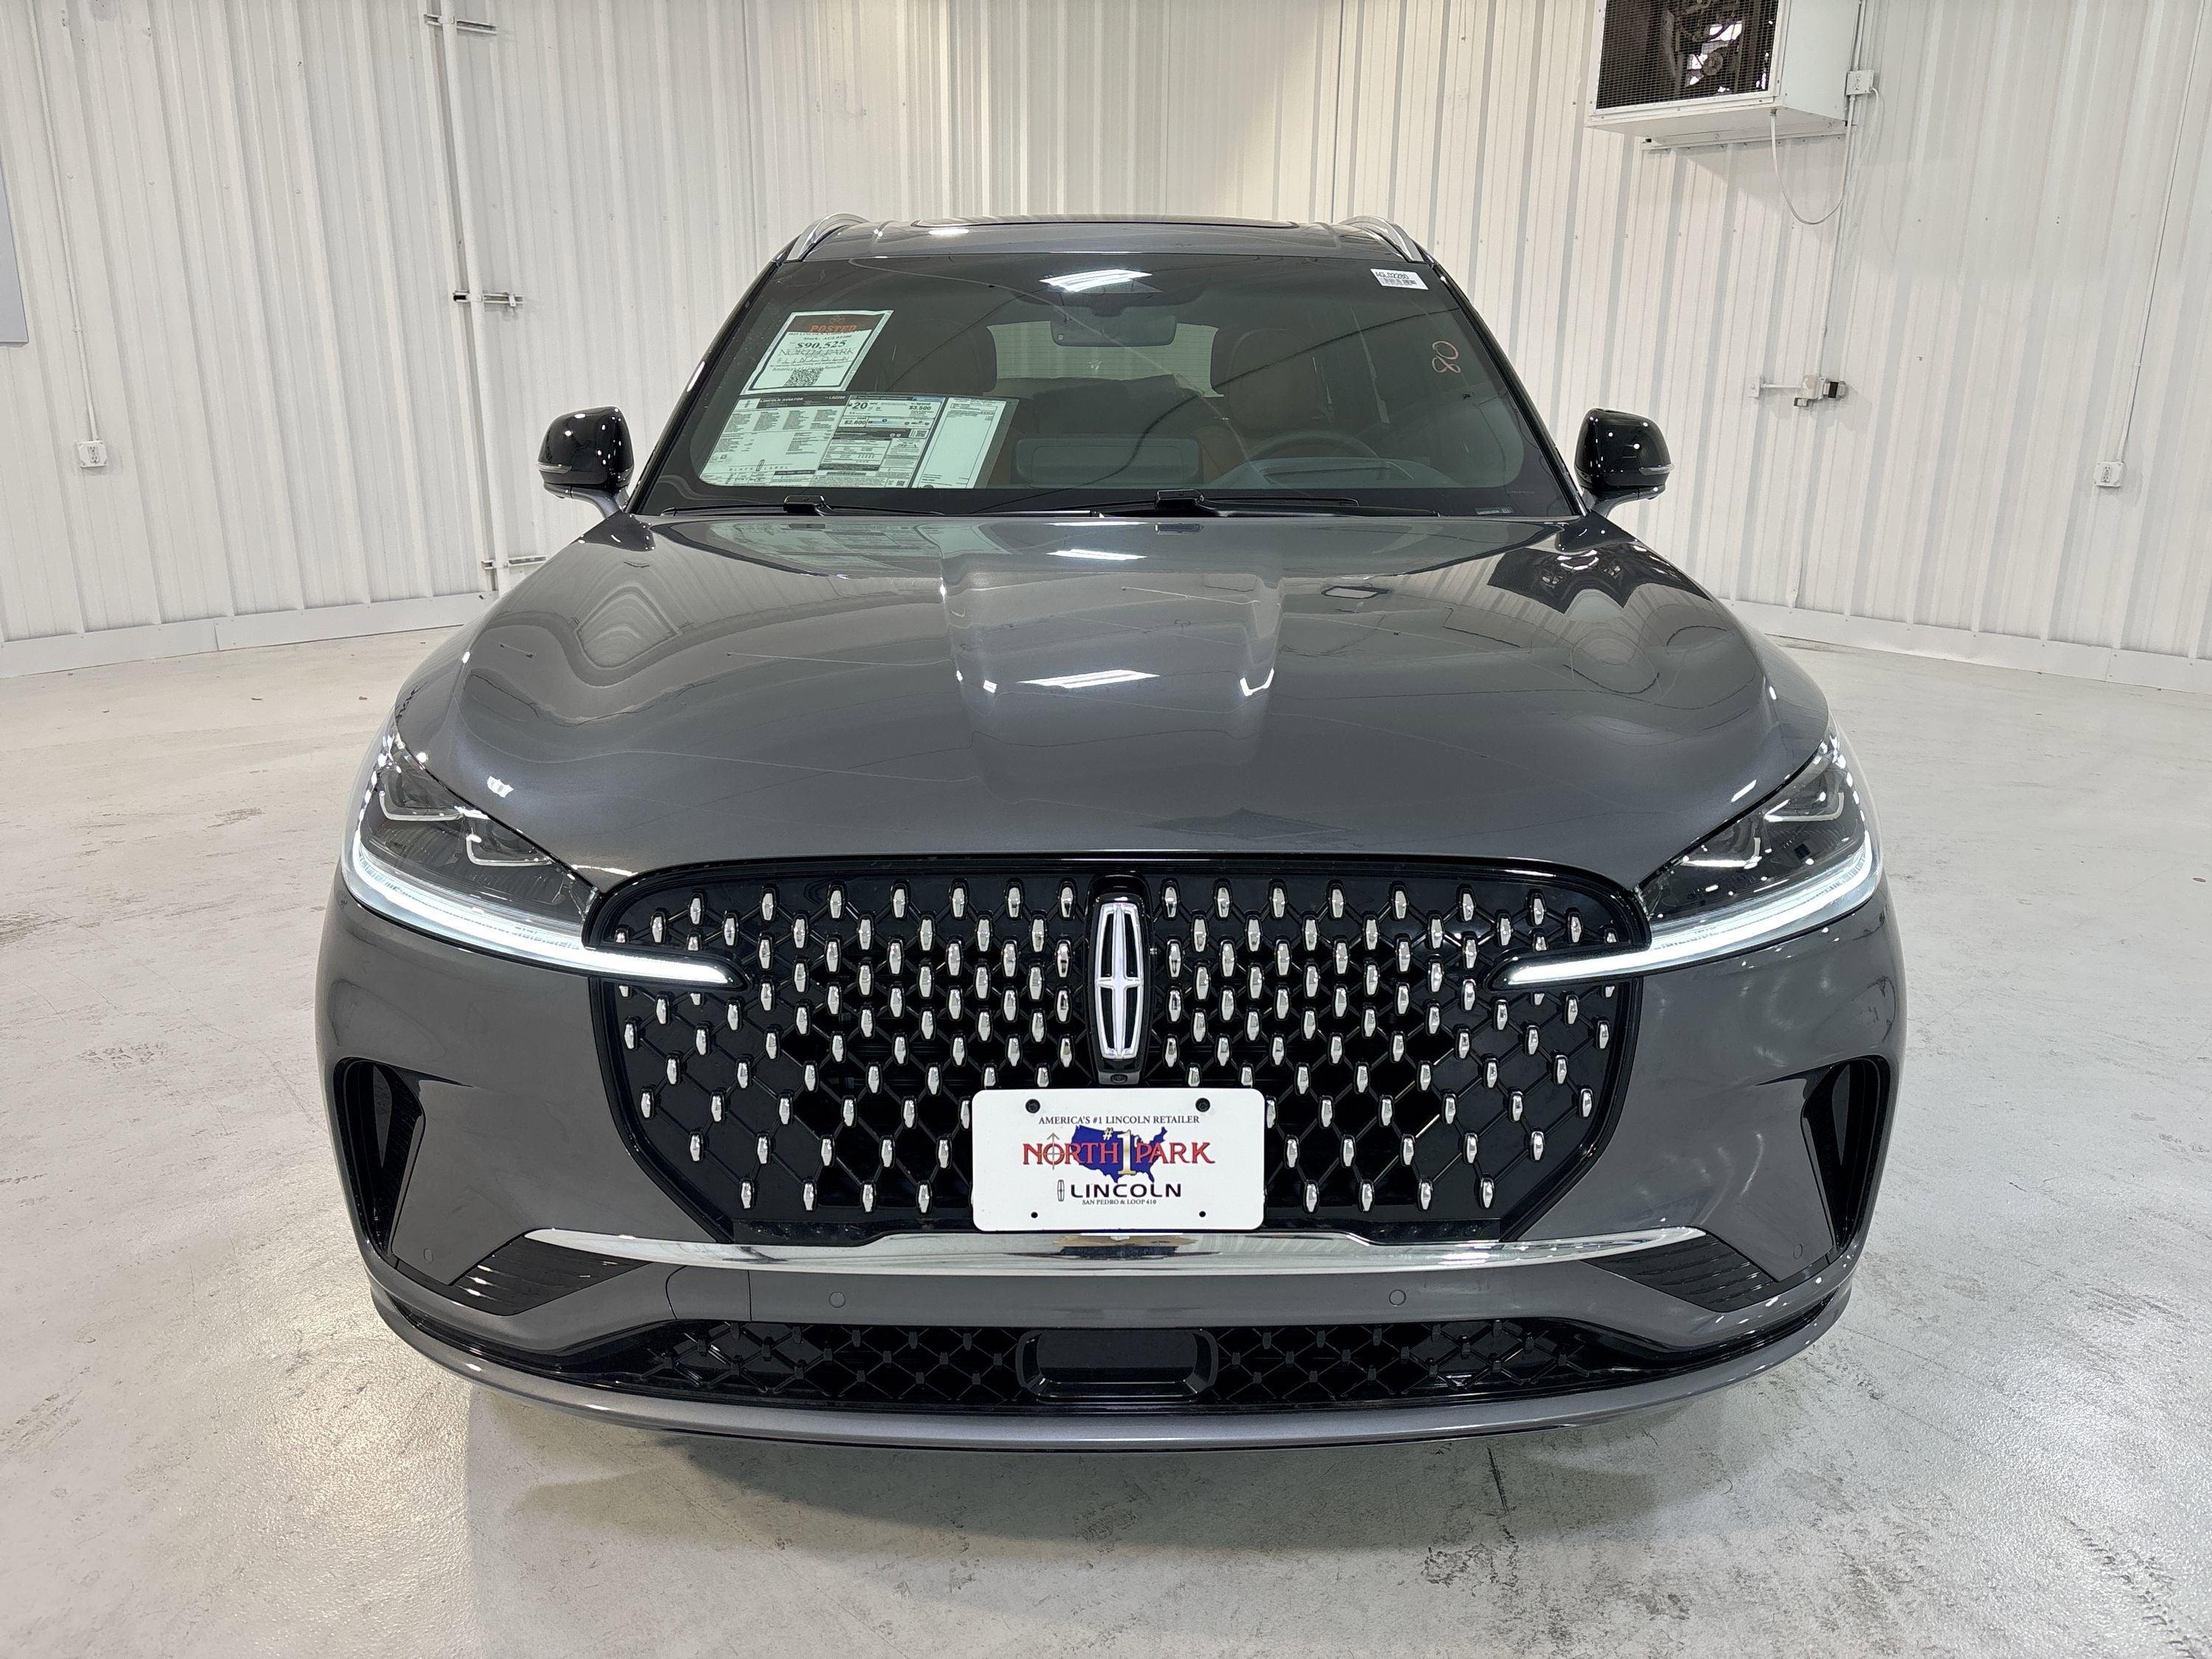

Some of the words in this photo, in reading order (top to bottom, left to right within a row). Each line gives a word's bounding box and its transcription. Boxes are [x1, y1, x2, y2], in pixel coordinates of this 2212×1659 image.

[796, 340, 847, 349] $90,525
[1038, 1116, 1091, 1124] AMERICA'S
[1106, 1116, 1152, 1124] LINCOLN
[1153, 1116, 1200, 1124] RETAILER
[1022, 1141, 1119, 1166] NORTH
[1135, 1141, 1216, 1164] PARK
[1070, 1183, 1182, 1198] LINCOLN
